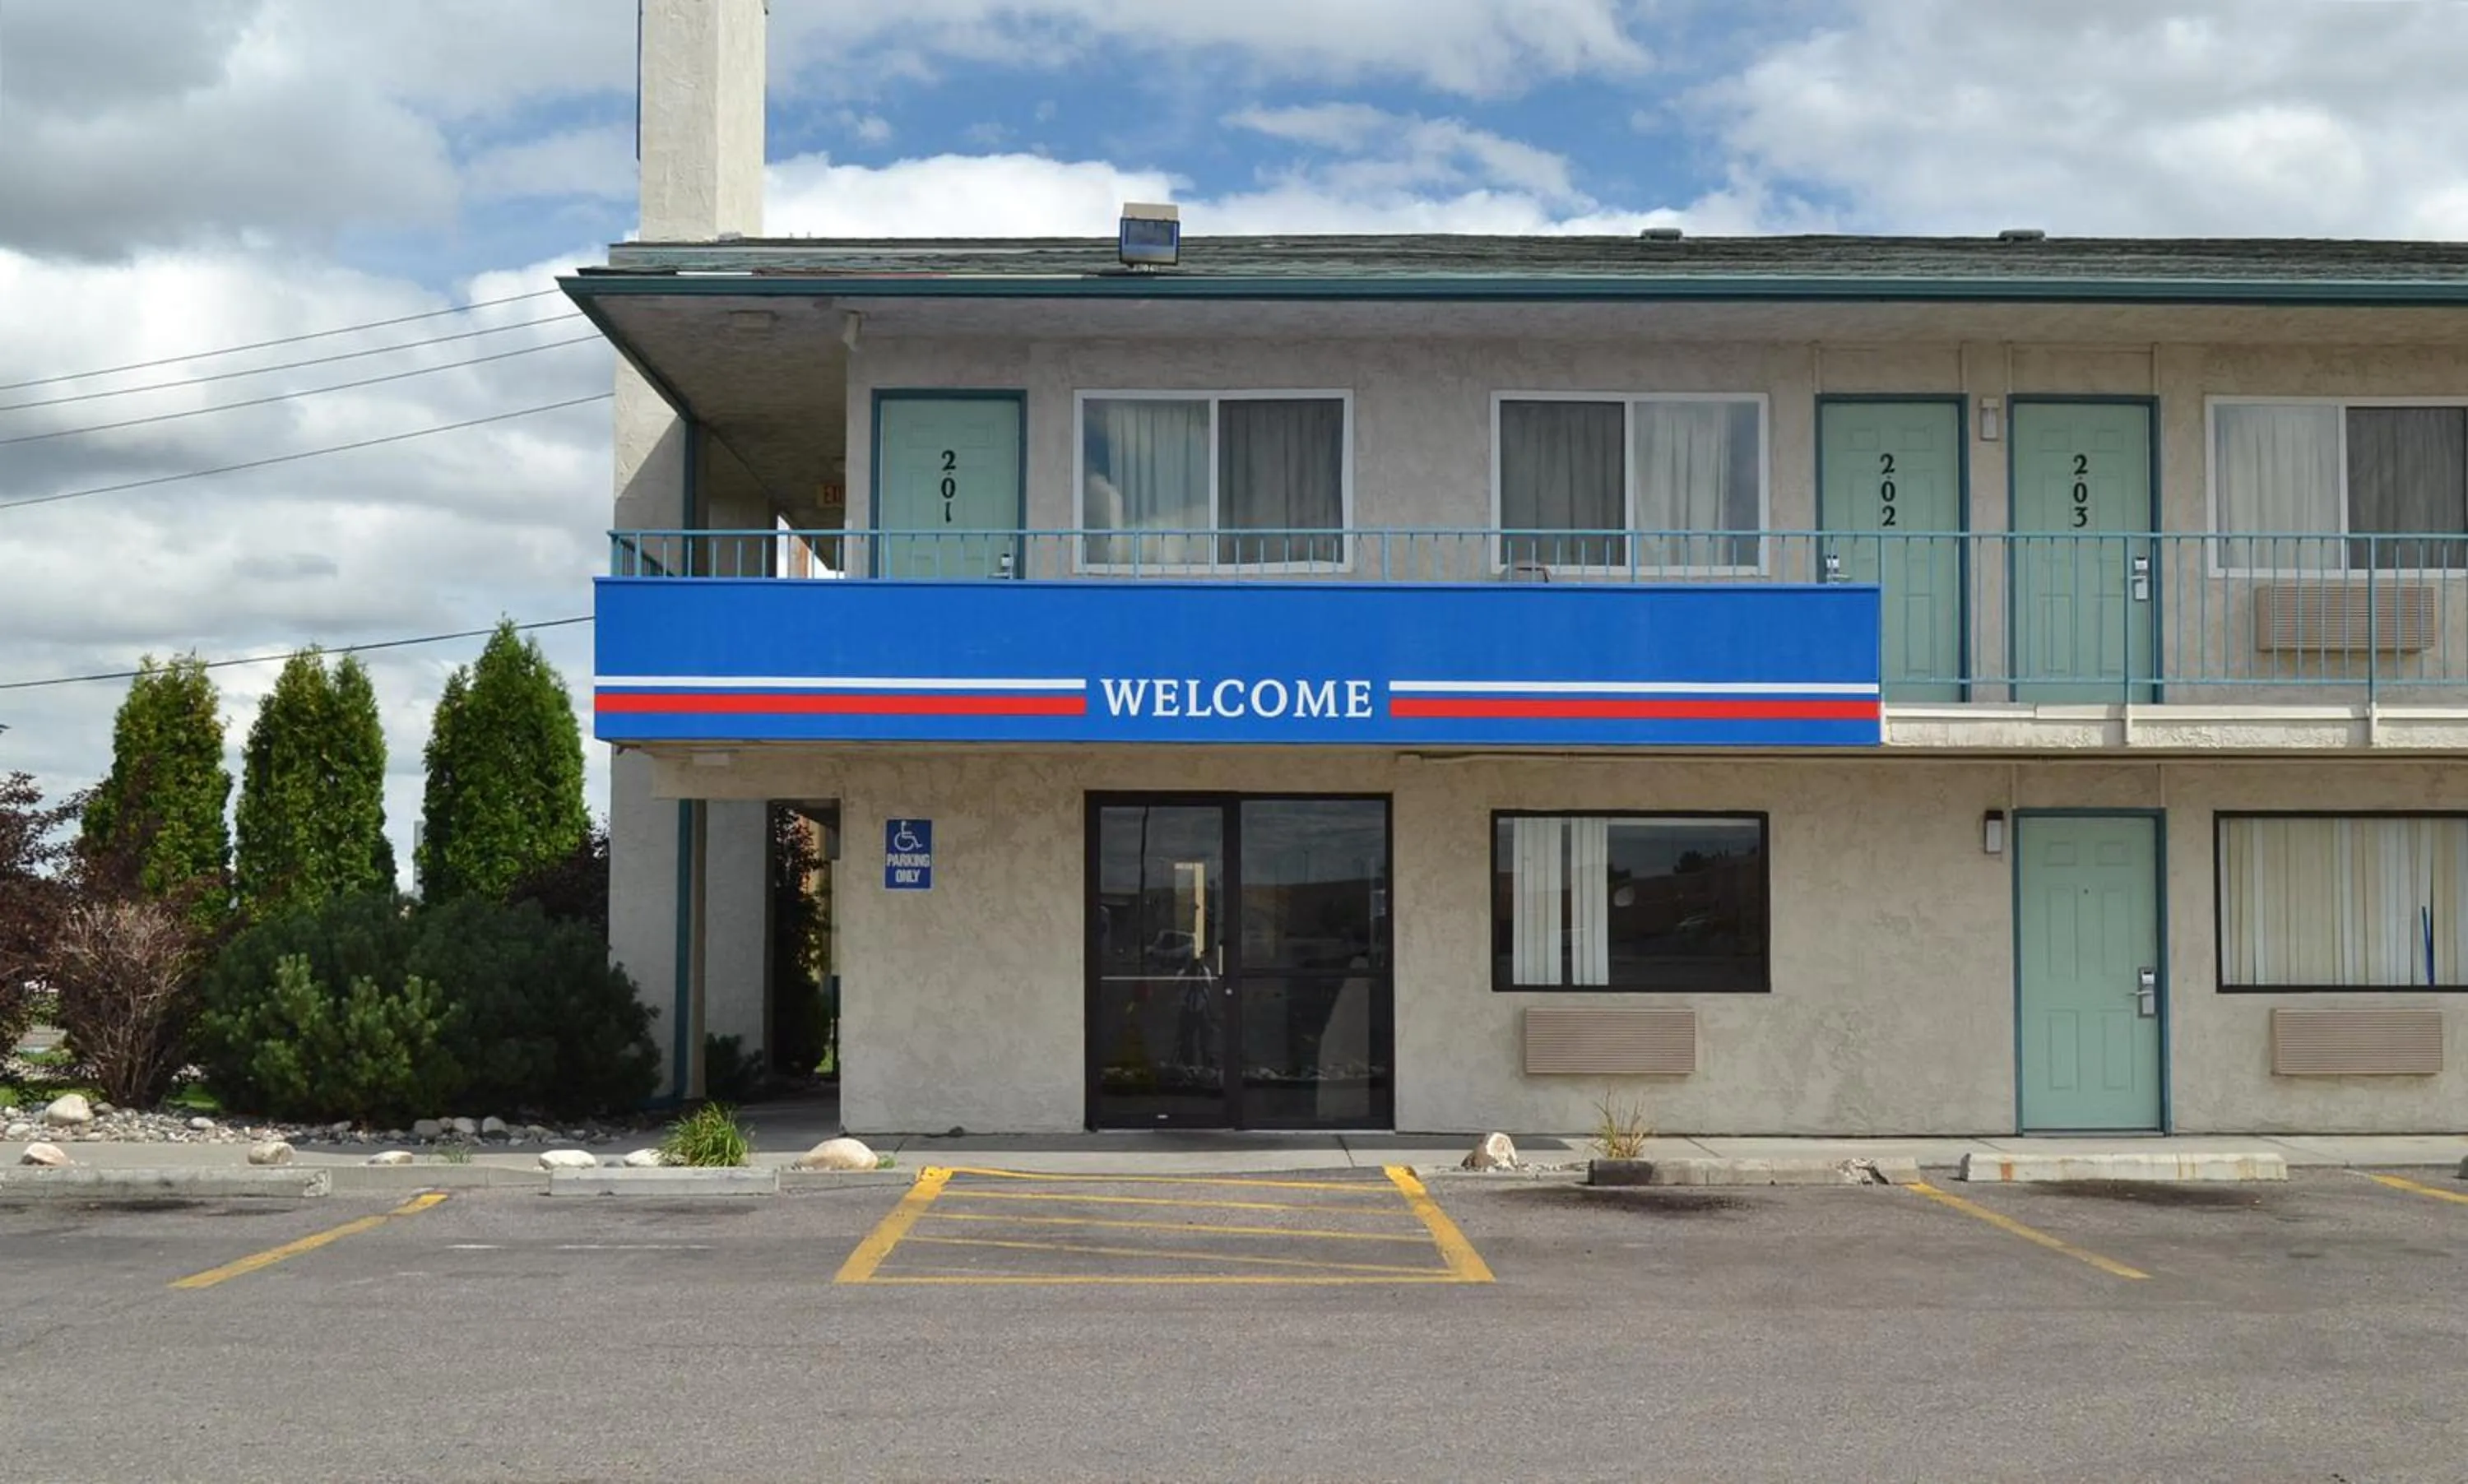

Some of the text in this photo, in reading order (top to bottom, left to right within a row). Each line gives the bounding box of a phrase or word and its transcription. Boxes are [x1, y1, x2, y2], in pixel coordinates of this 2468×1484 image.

[941, 449, 956, 523] 201
[1880, 453, 1895, 526] 202
[2072, 454, 2088, 528] 203
[1100, 679, 1373, 718] WELCOME
[887, 853, 930, 867] PARKING
[895, 869, 921, 883] ONLY
